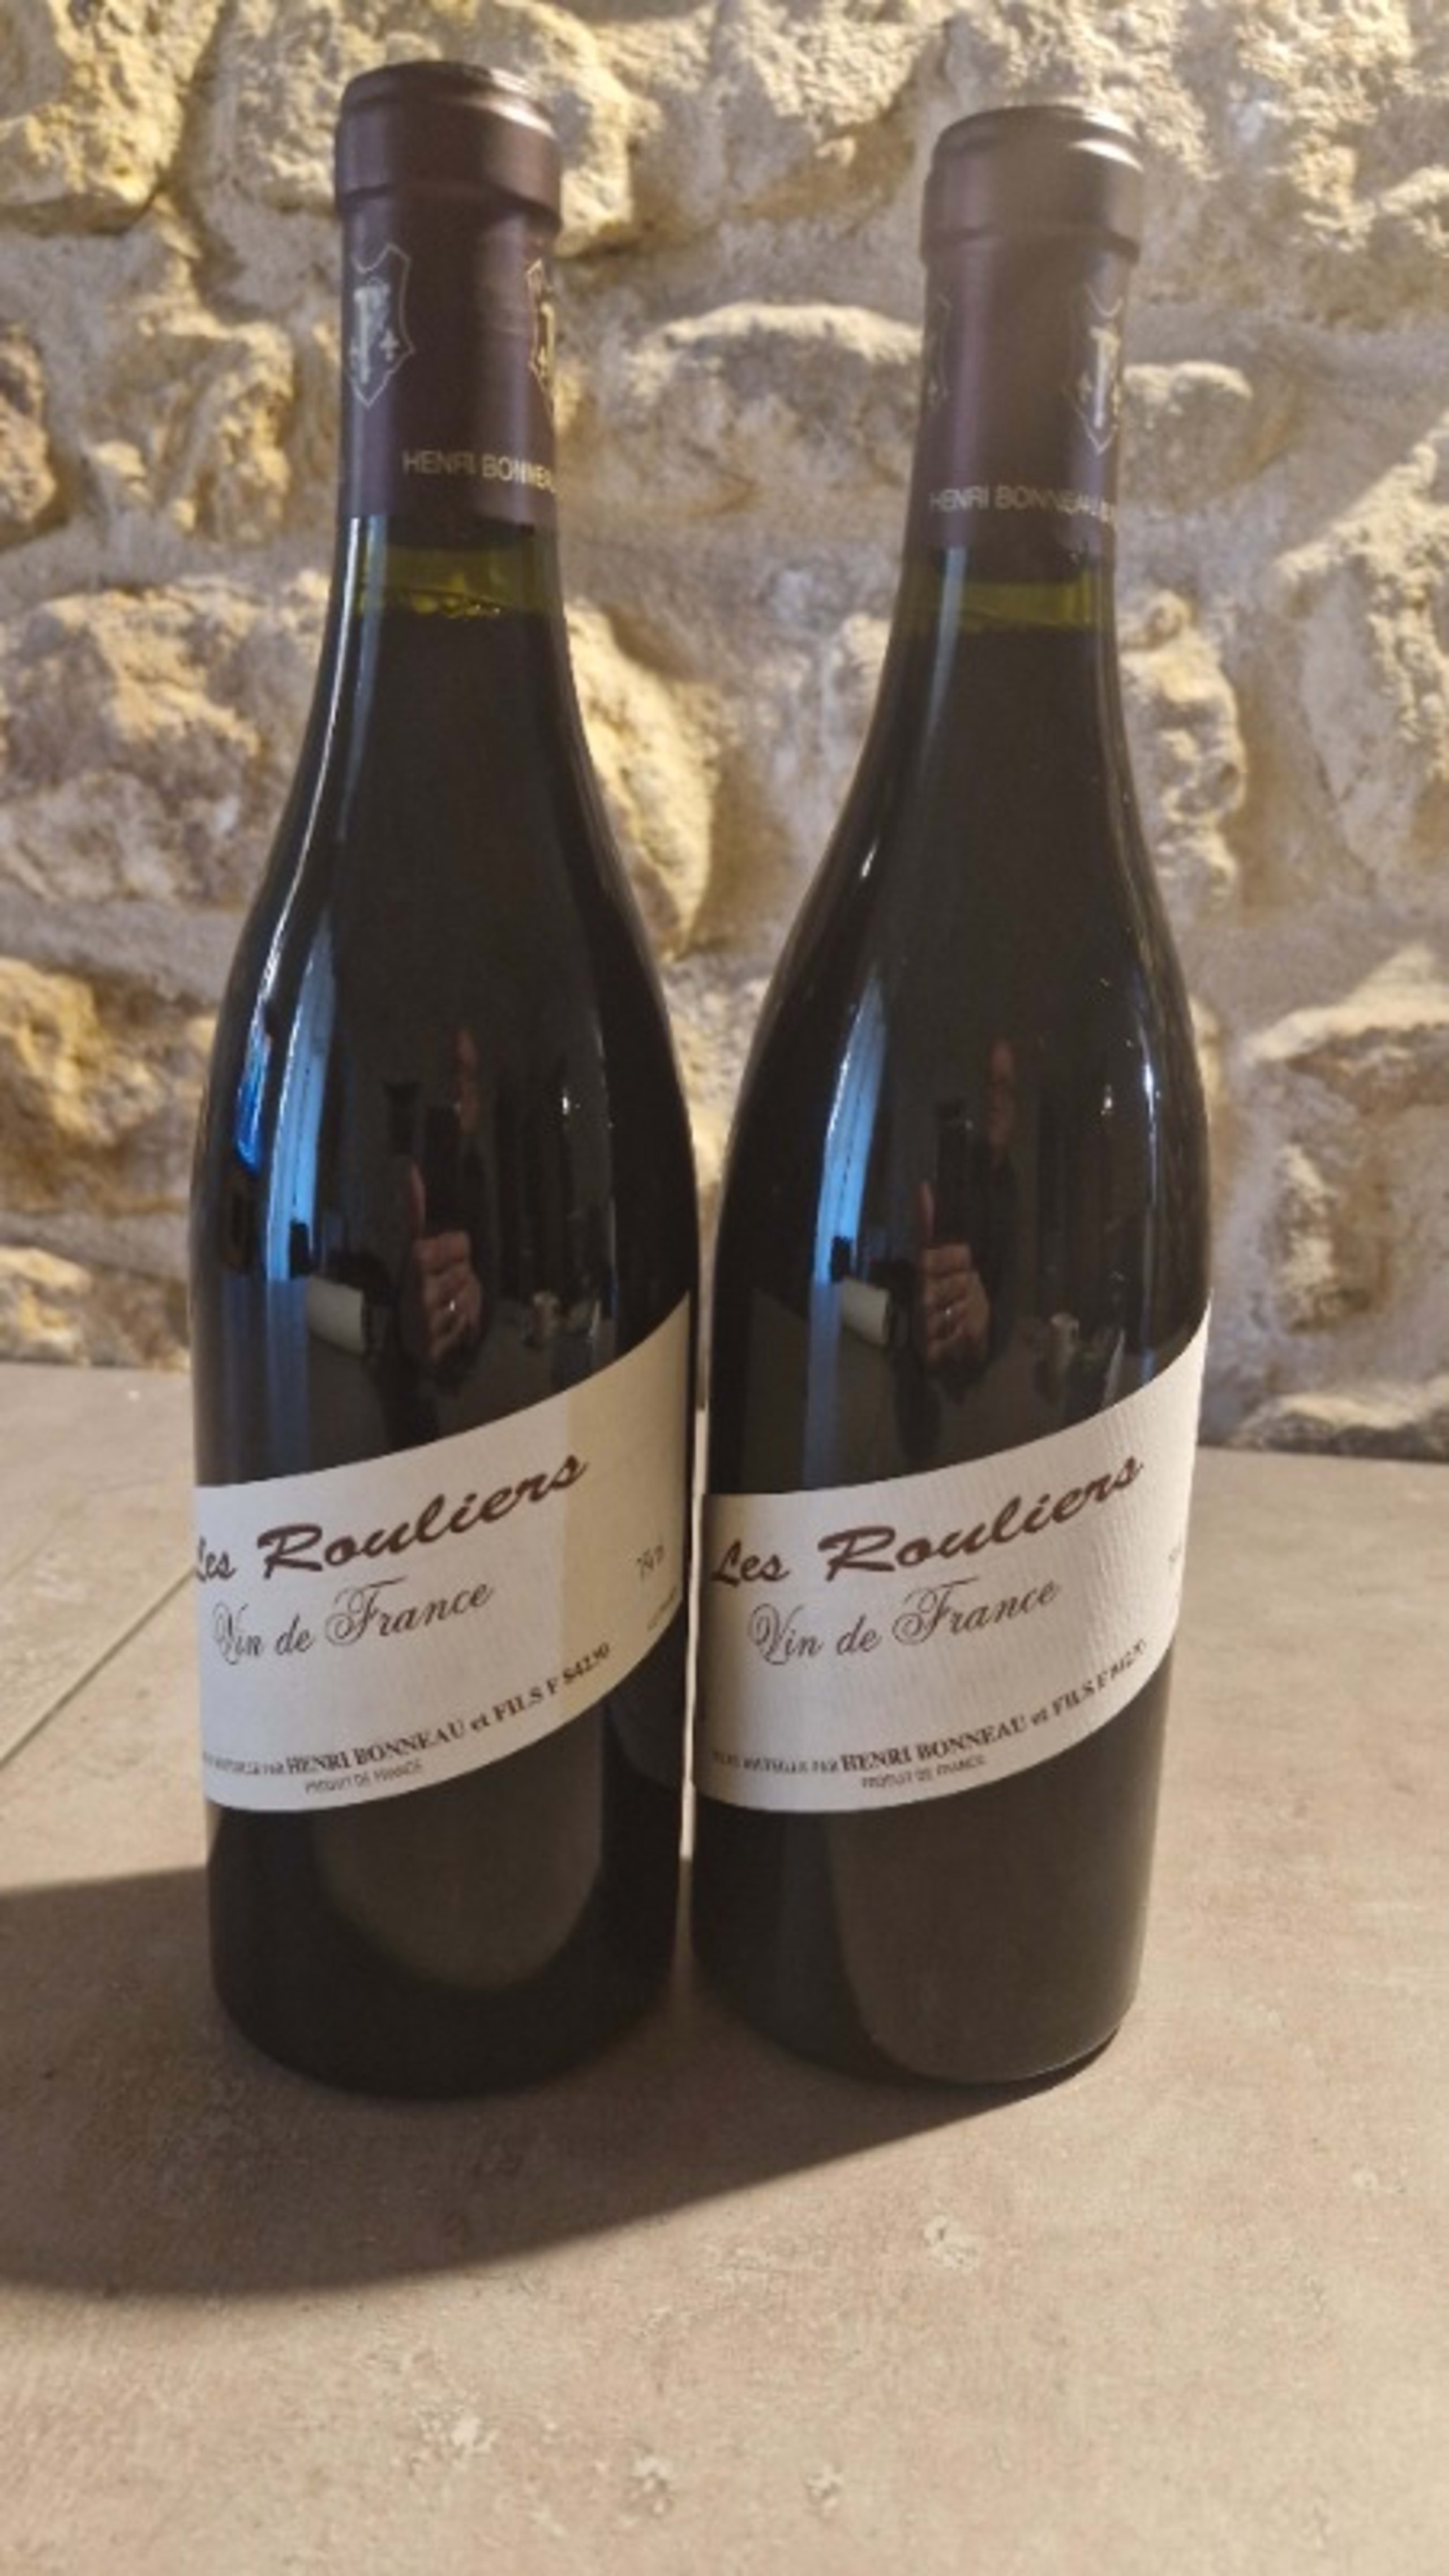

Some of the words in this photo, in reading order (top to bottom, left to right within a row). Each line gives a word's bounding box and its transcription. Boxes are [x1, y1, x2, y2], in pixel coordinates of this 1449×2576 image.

[402, 451, 477, 474] HENRI
[929, 485, 989, 512] HENRI
[258, 1455, 588, 1579] Rouliers
[711, 1540, 790, 1587] Les
[817, 1455, 1144, 1582] Rouliers
[213, 1601, 264, 1666] Vin
[274, 1612, 313, 1656] de
[324, 1575, 494, 1647] France
[748, 1602, 824, 1666] Vin
[837, 1614, 881, 1656] de
[891, 1575, 1059, 1645] France
[286, 1750, 350, 1774] HENRI
[353, 1719, 464, 1766] BONNEAU
[470, 1712, 491, 1732] et
[492, 1686, 545, 1722] FILS
[546, 1676, 559, 1695] F
[841, 1746, 911, 1773] HENRI
[915, 1717, 1027, 1761] BONNEAU
[1031, 1708, 1048, 1725] et
[1052, 1679, 1096, 1717] FILS
[916, 1768, 932, 1781] DE
[937, 1756, 985, 1776] FRANCE
[355, 1772, 371, 1788] DE
